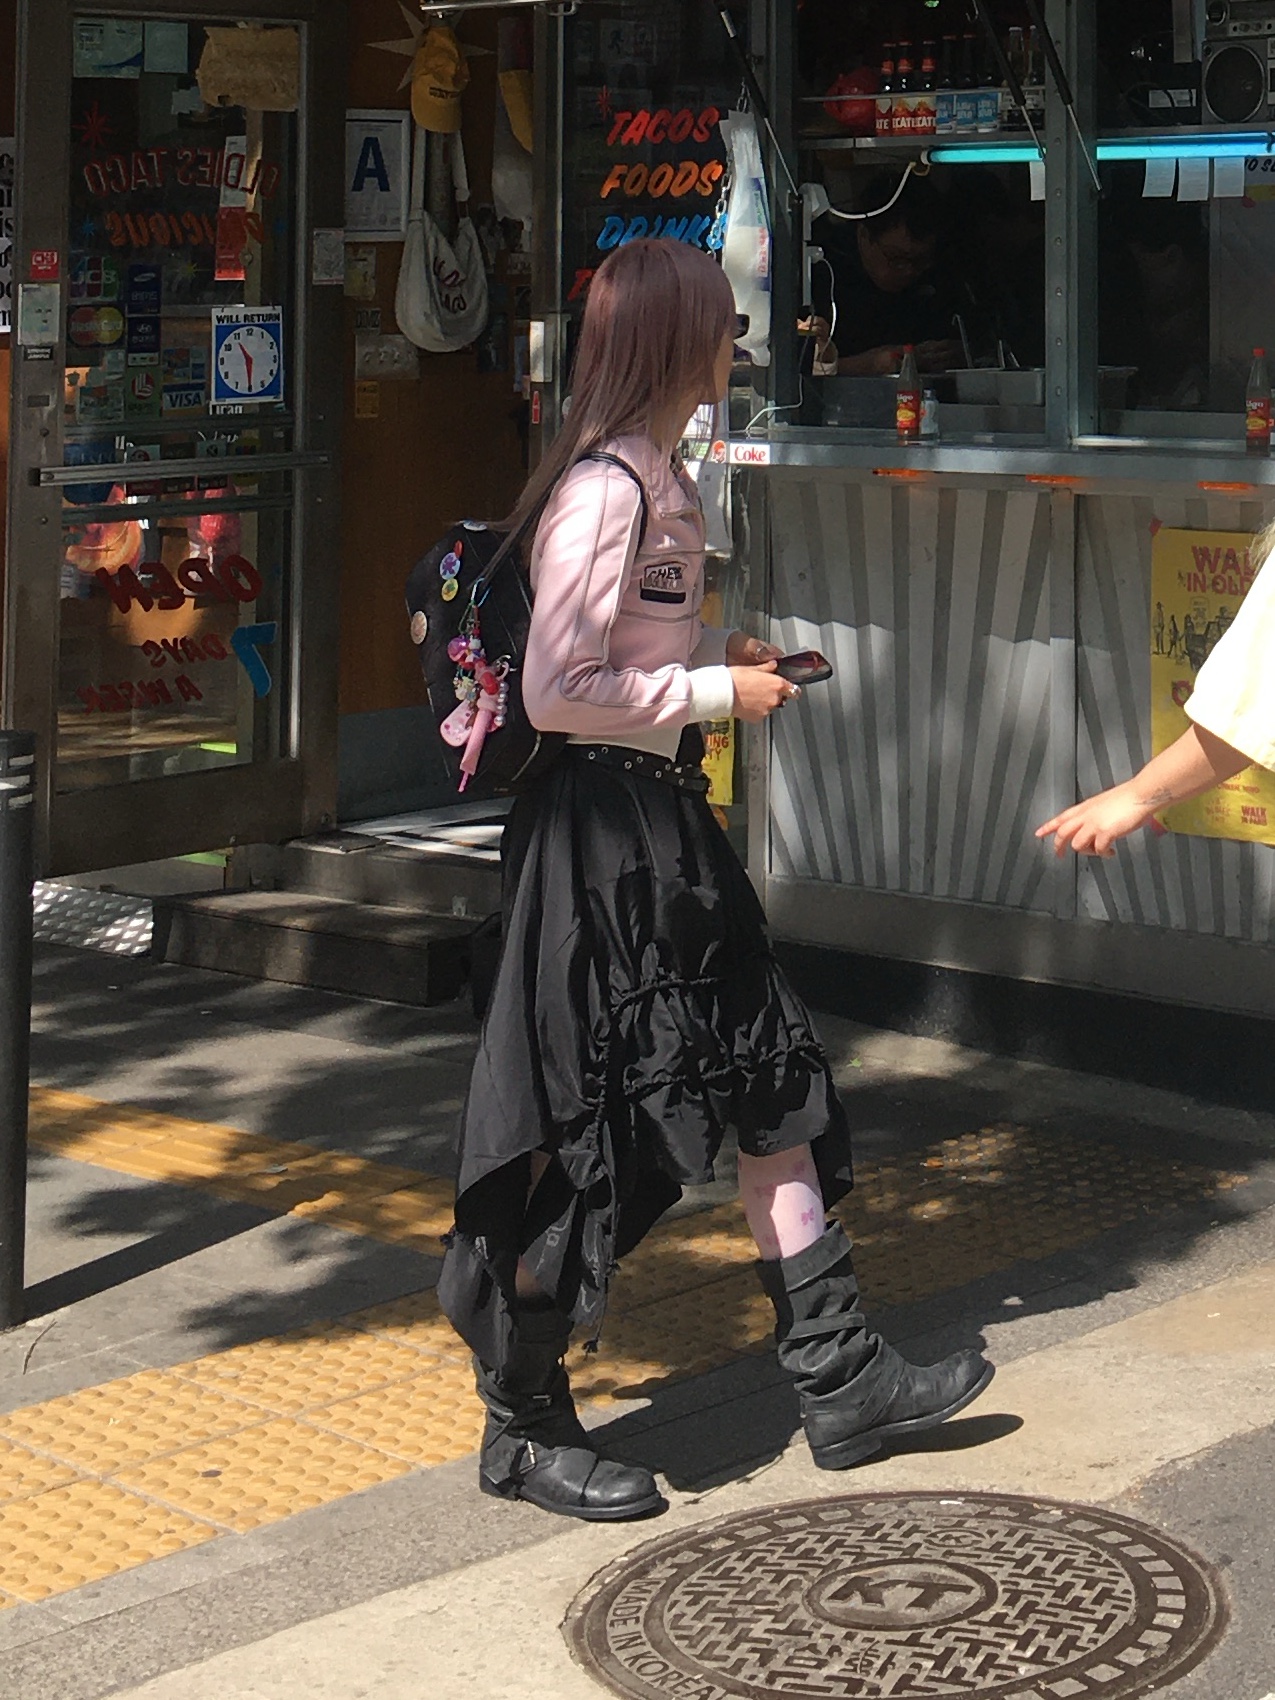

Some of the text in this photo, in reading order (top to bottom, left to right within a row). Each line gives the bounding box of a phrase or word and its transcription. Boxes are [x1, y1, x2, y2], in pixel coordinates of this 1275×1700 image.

[606, 106, 721, 146] TACOS
[352, 137, 390, 191] A
[599, 158, 724, 199] FOODS
[216, 313, 280, 324] WILL RETURN
[234, 332, 241, 341] 11
[246, 328, 254, 336] 12
[260, 332, 264, 340] 1
[224, 343, 232, 352] 10
[269, 342, 274, 350] 2
[273, 355, 277, 363] 3
[269, 369, 274, 377] 4
[235, 382, 239, 390] 7
[168, 393, 201, 408] VISA
[734, 445, 766, 462] Coke
[1191, 545, 1256, 575] WAL
[1186, 572, 1207, 593] IN
[824, 1574, 977, 1610] KT
[608, 1580, 663, 1629] MADE
[610, 1630, 647, 1652] IN
